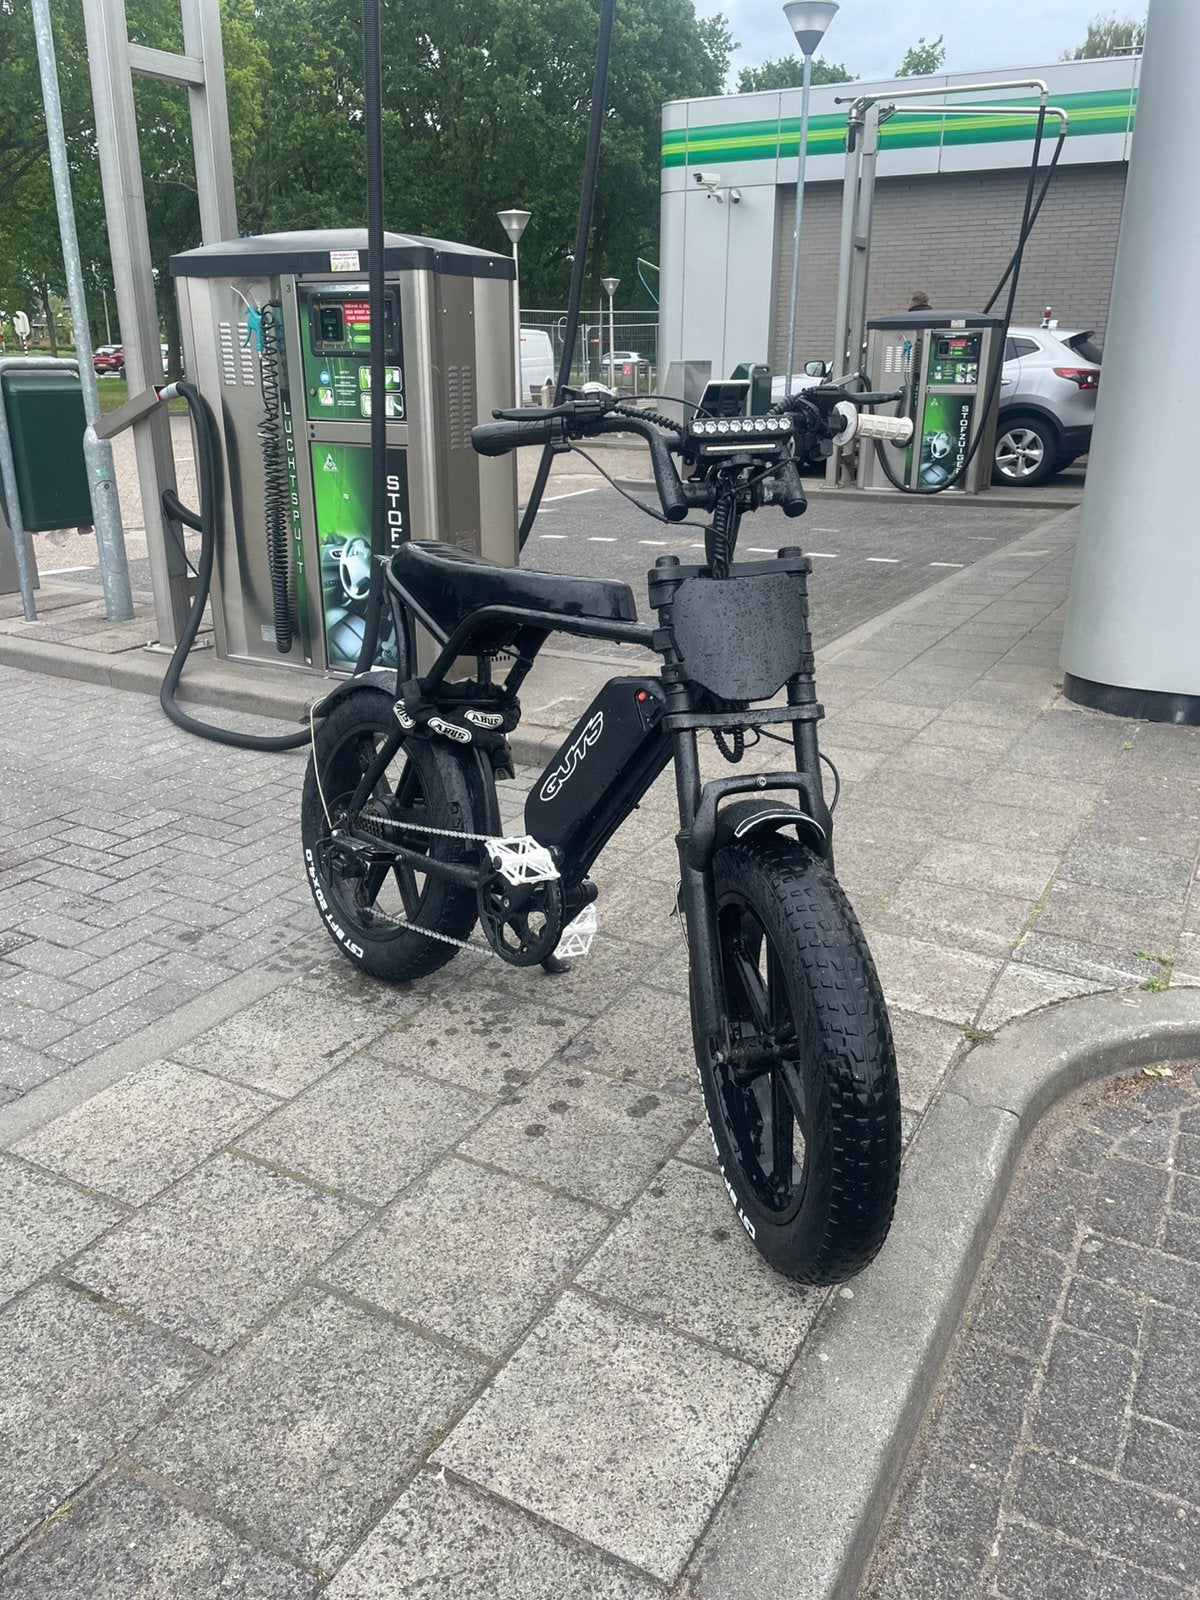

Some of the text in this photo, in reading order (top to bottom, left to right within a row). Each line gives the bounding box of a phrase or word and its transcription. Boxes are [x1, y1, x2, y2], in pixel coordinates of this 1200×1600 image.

[283, 402, 304, 575] LUCHTSPUIT
[386, 475, 402, 549] STOF
[434, 723, 466, 741] ABUS
[471, 713, 500, 727] ABUS
[540, 711, 603, 801] GUTS
